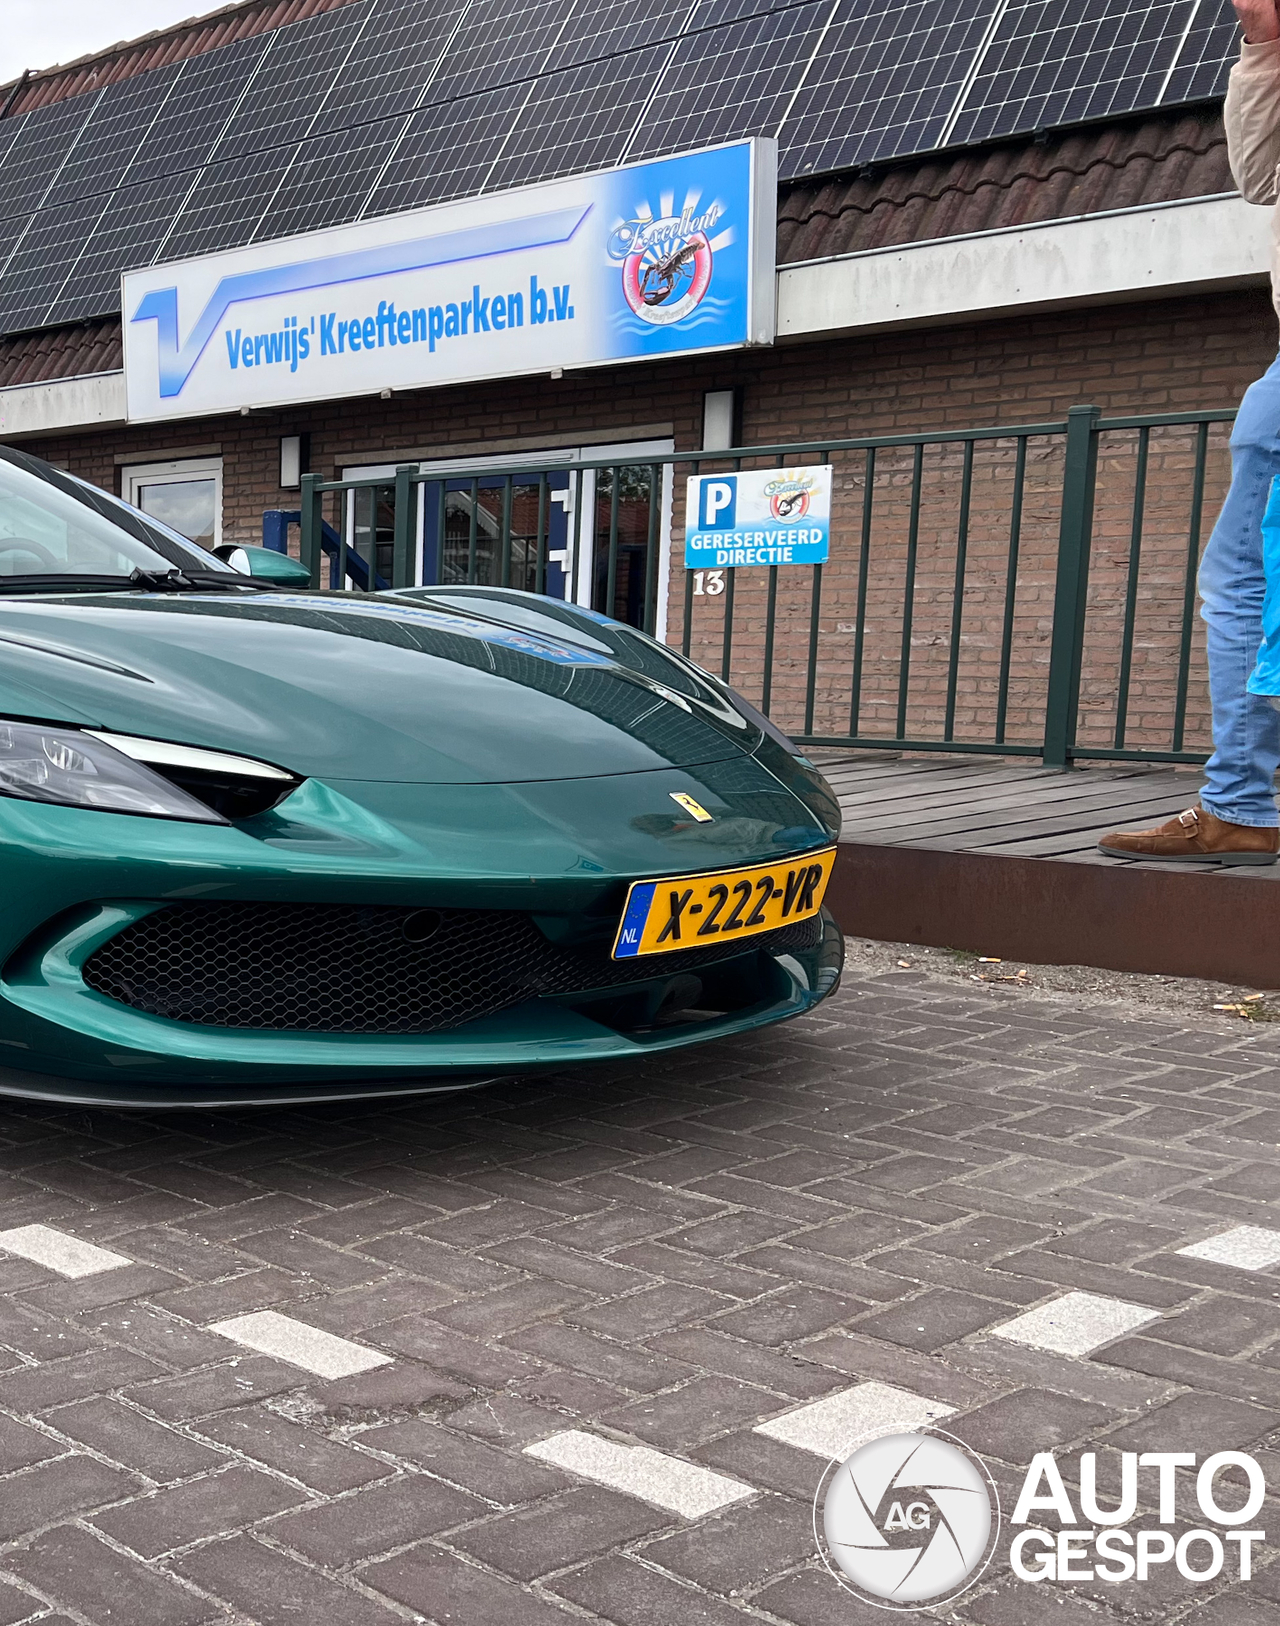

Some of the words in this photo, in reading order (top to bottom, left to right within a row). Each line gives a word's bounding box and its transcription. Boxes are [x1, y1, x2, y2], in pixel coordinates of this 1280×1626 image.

[607, 205, 720, 260] Excellent
[225, 316, 315, 373] Verwijs'
[320, 285, 524, 353] Kreeftenparken
[530, 275, 575, 325] b.v.
[705, 482, 732, 525] P
[690, 528, 823, 550] GERESERVEERD
[716, 547, 793, 565] DIRECTIE
[693, 570, 725, 596] 13
[656, 863, 823, 943] X-222-VR
[621, 927, 638, 945] NL
